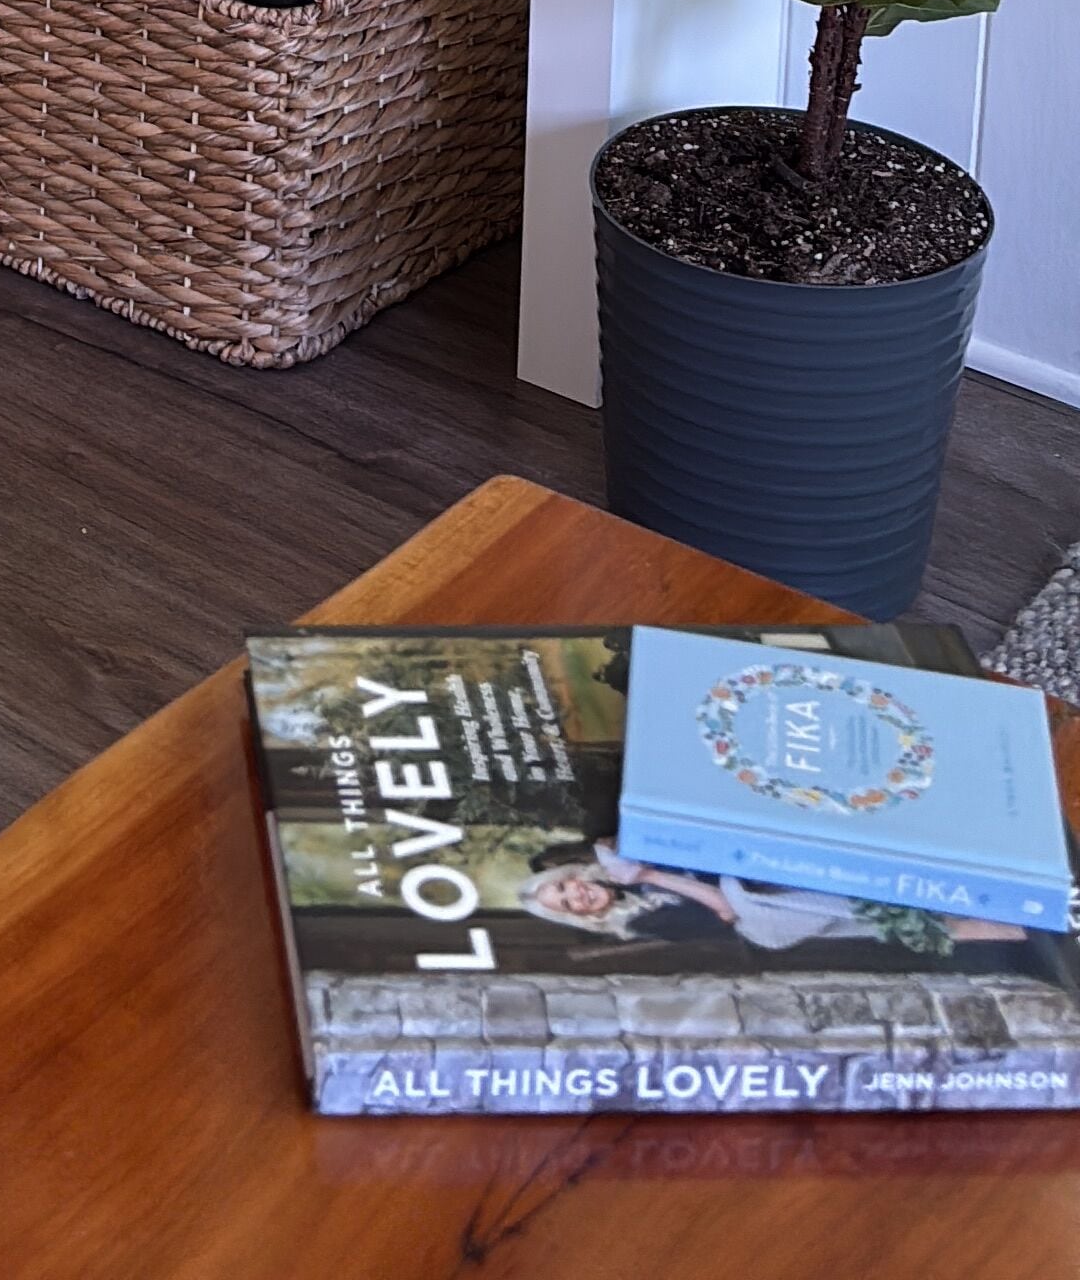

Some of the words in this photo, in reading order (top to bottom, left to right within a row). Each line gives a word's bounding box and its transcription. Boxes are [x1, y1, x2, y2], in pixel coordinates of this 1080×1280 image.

[479, 682, 510, 751] Wholeness
[784, 700, 820, 772] FIKA
[461, 720, 490, 781] Inspiring
[493, 754, 518, 782] and
[519, 731, 541, 763] Your
[329, 735, 368, 833] THINGS
[356, 676, 498, 970] LOVELY
[353, 844, 382, 898] ALL
[896, 872, 973, 908] FIKA
[373, 1068, 451, 1099] ALL
[466, 1067, 619, 1097] THINGS
[637, 1064, 829, 1100] LOVELY
[864, 1071, 934, 1092] JENN
[940, 1070, 1069, 1092] JOHNSON
